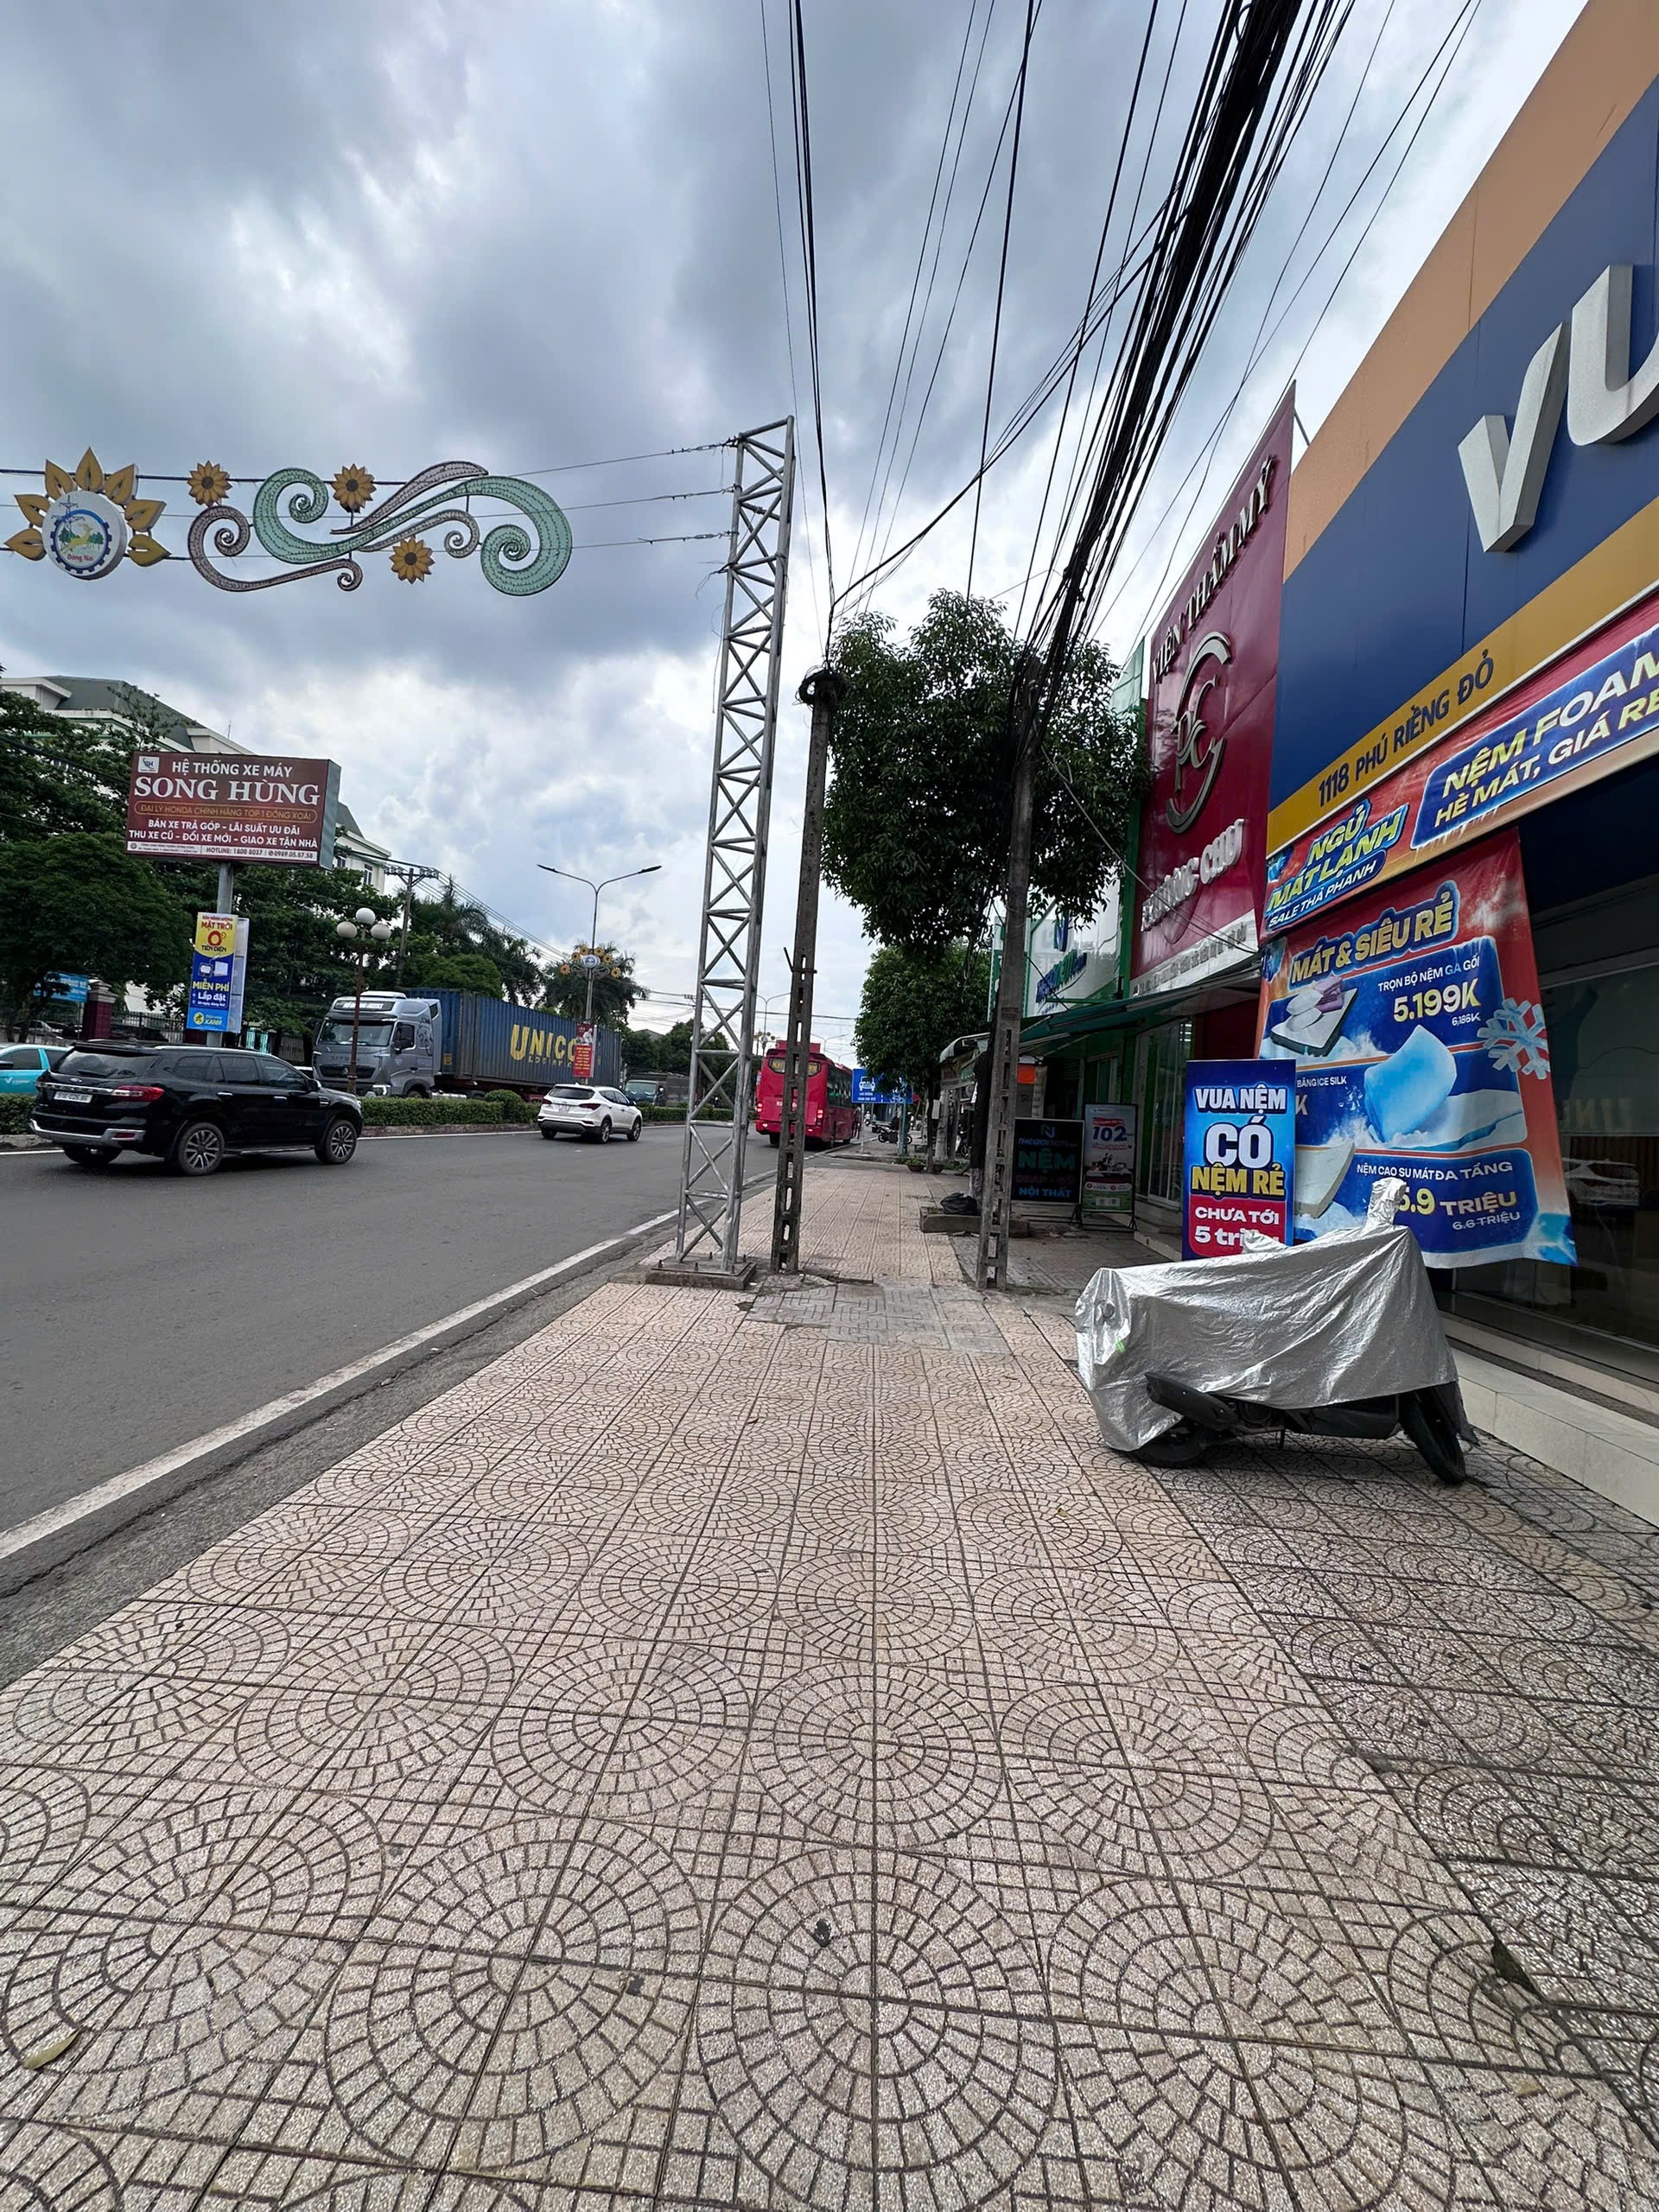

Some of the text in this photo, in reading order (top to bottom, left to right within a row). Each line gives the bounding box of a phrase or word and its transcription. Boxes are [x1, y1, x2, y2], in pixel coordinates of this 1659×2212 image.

[1319, 649, 1494, 807] 1118 PHÚ RIỀNG ĐỎ
[172, 759, 293, 778] HỆ THỐNG XE MÁY
[1434, 792, 1469, 828] HÈ
[1471, 753, 1541, 808] MÁT,
[1548, 710, 1611, 766] GIÁ
[1442, 728, 1528, 798] NỆM
[135, 777, 321, 806] SONG HÙNG
[164, 805, 192, 814] HONDA
[129, 830, 146, 838] THU
[148, 830, 159, 839] XE
[161, 830, 174, 840] CŨ
[182, 830, 200, 841] ĐỔI
[213, 832, 232, 842] MỚI
[240, 836, 264, 844] GIAO
[279, 836, 297, 849] TẬN
[298, 836, 318, 849] NHÀ
[148, 818, 167, 828] BÁN
[168, 820, 180, 829] XE
[181, 819, 199, 830] TRẢ
[200, 819, 221, 830] GÓP
[229, 822, 243, 831] LÃI
[245, 823, 268, 834] SUẤT
[283, 825, 301, 835] ĐÃI
[1306, 804, 1366, 867] NGỦ
[1266, 810, 1402, 912] MÁT LẠNH
[1268, 860, 1376, 925] SALE THẢ PHANH
[1291, 944, 1335, 984] MÁT
[1335, 940, 1352, 968] &
[1354, 917, 1410, 962] SIÊU
[1414, 891, 1453, 942] RẺ
[193, 978, 230, 992] MIỄN PHÍ
[1378, 953, 1480, 993] TRỌN BỘ NỆM GA GỐI
[198, 991, 226, 1003] Lắp đặt
[1393, 978, 1481, 1022] 5.199K
[1317, 1077, 1329, 1086] ICE
[1330, 1075, 1347, 1086] SILK
[1195, 1084, 1287, 1114] VUA NỆM
[1092, 1125, 1128, 1142] 102
[1205, 1115, 1272, 1169] CÓ
[1017, 1147, 1076, 1175] NỆM
[1357, 1161, 1513, 1180] NỆM CAO SU MÁT ĐA TẦNG
[1018, 1185, 1039, 1198] NỘI
[1192, 1163, 1285, 1196] NỆM RẺ
[1195, 1207, 1279, 1224] CHƯA TỚI
[1440, 1191, 1518, 1217] TRIỆU
[1452, 1211, 1522, 1230] 6.6 TRIỆU
[1195, 1226, 1279, 1247] 5 tri
